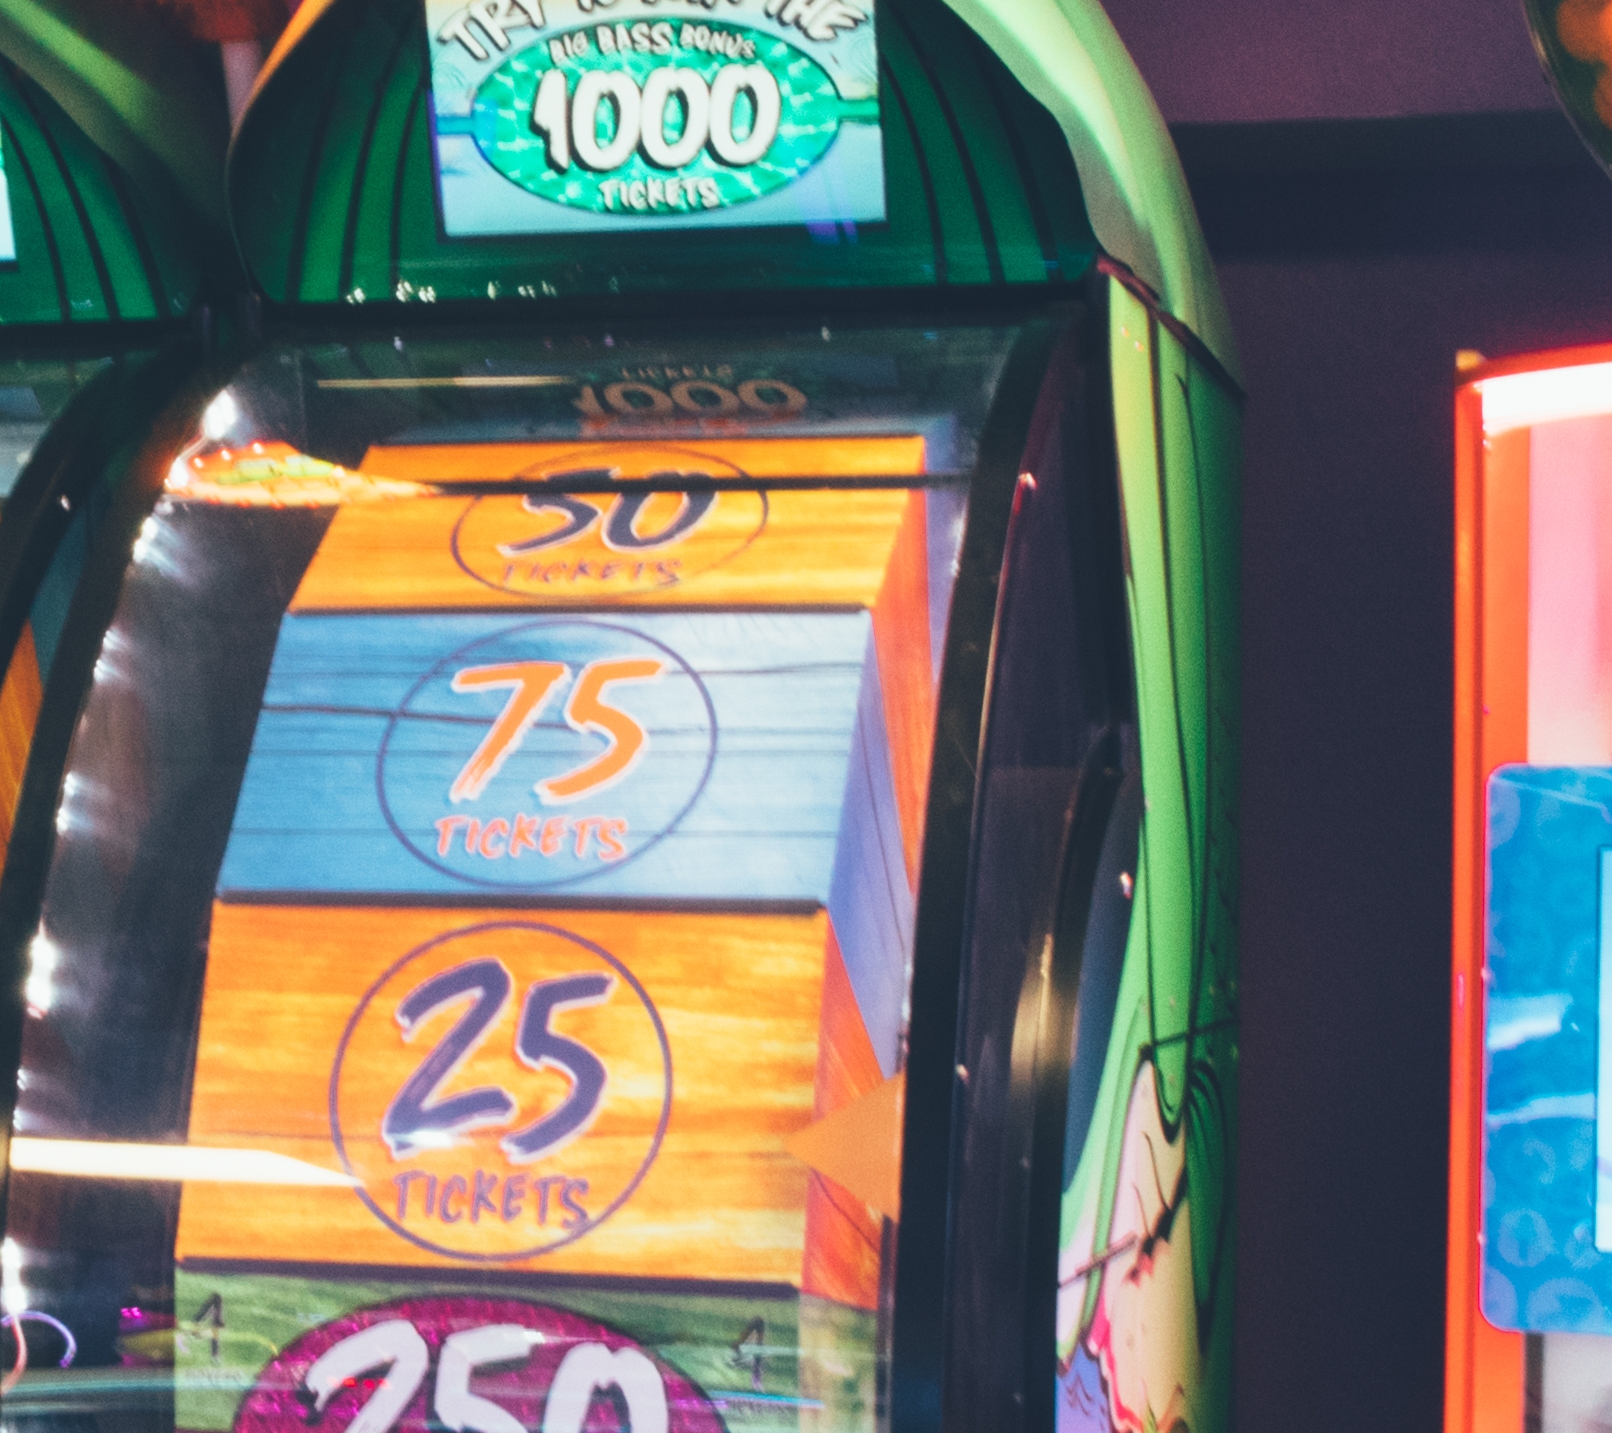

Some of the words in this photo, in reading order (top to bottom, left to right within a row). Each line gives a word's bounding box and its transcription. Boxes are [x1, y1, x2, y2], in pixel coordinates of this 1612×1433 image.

[548, 35, 589, 66] BIG
[596, 23, 674, 56] BASS
[678, 24, 757, 61] BONUS
[529, 63, 784, 174] 1000
[598, 177, 721, 210] TICKETS
[449, 657, 672, 805] 75
[433, 813, 629, 861] TICKETS
[381, 956, 619, 1165] 25
[393, 1167, 592, 1232] TICKETS
